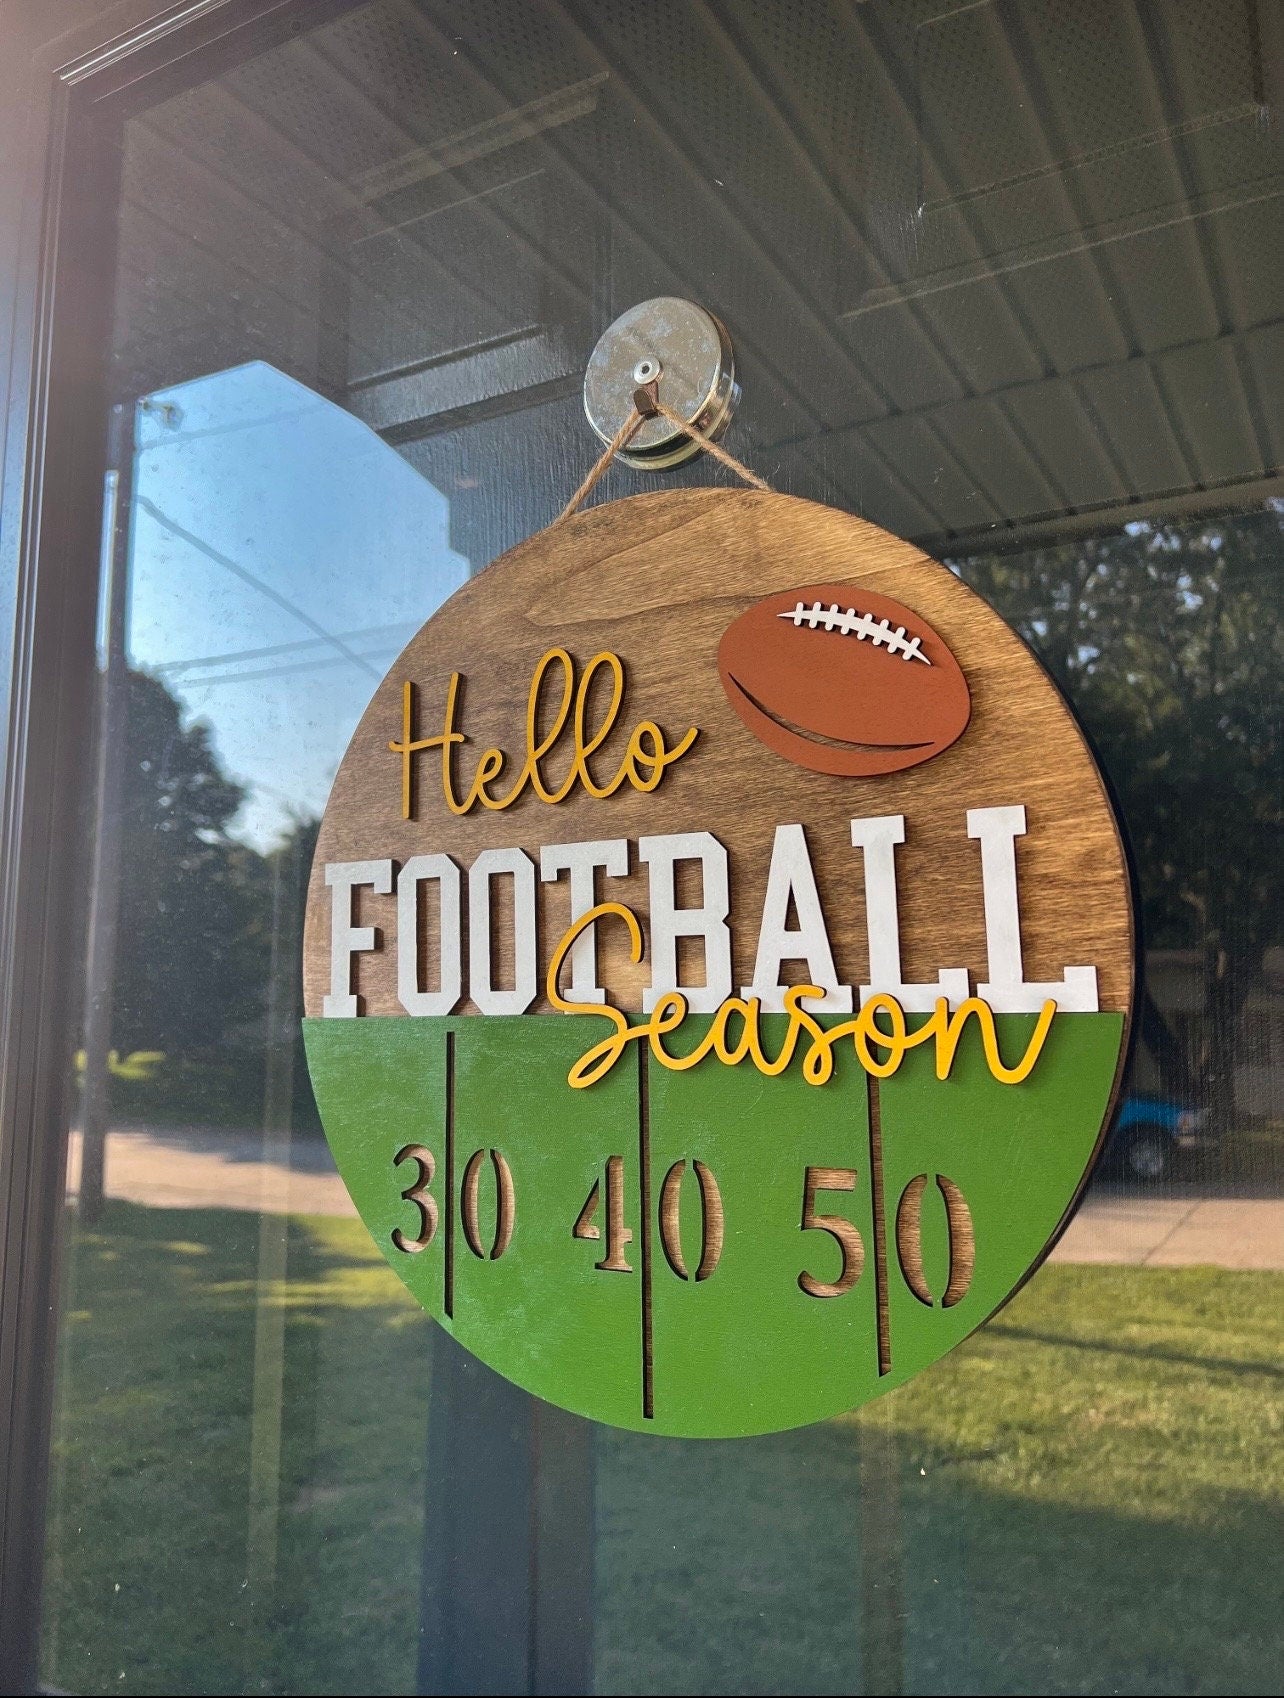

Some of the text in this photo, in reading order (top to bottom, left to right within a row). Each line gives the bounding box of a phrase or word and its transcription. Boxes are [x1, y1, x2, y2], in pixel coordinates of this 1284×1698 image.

[389, 648, 698, 818] Hello
[323, 804, 1099, 1018] FOOTBALL
[546, 902, 1058, 1089] Season
[391, 1144, 975, 1308] 30 40 50
